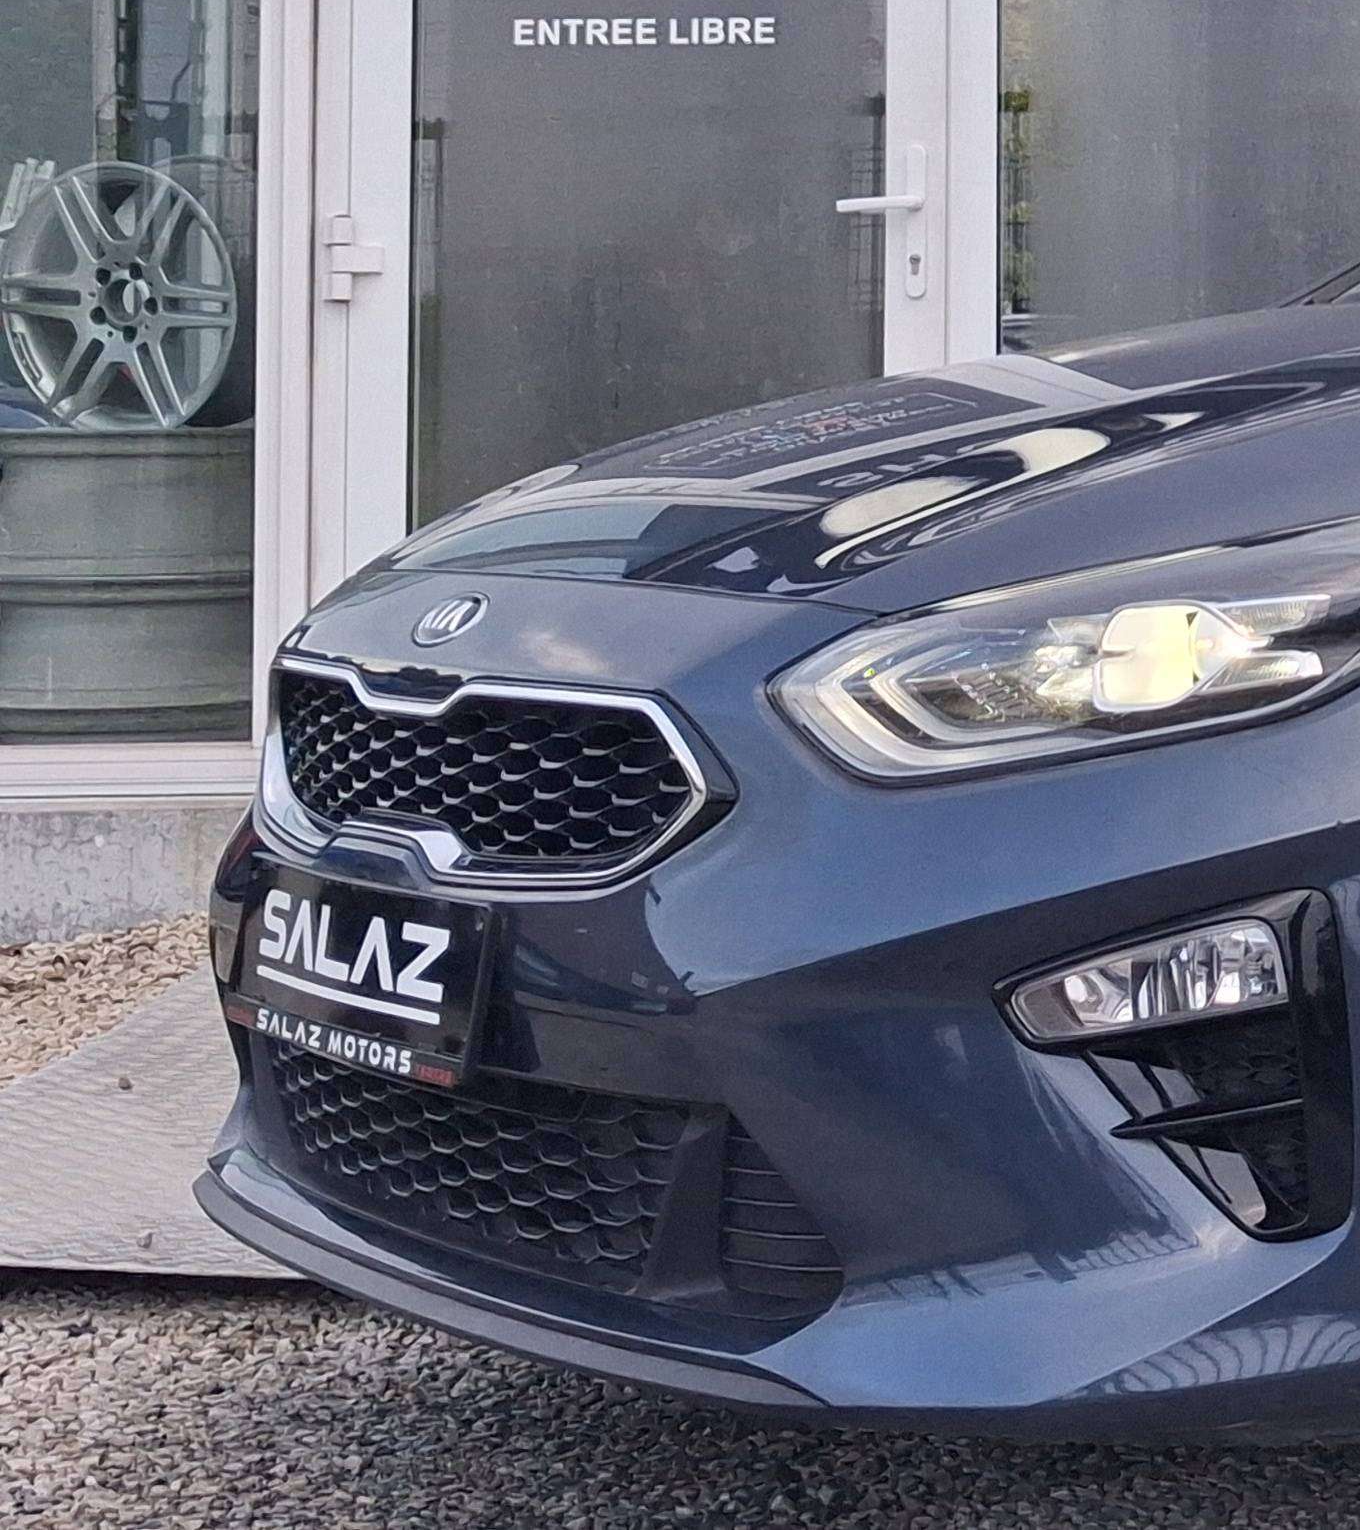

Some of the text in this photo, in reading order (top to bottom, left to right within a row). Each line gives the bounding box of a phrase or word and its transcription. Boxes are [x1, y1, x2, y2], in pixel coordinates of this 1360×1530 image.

[513, 17, 776, 46] ENTREE LIBRE
[258, 890, 451, 1003] SALAZ
[256, 1007, 322, 1049] SALAZ
[326, 1031, 412, 1075] MOTORS
